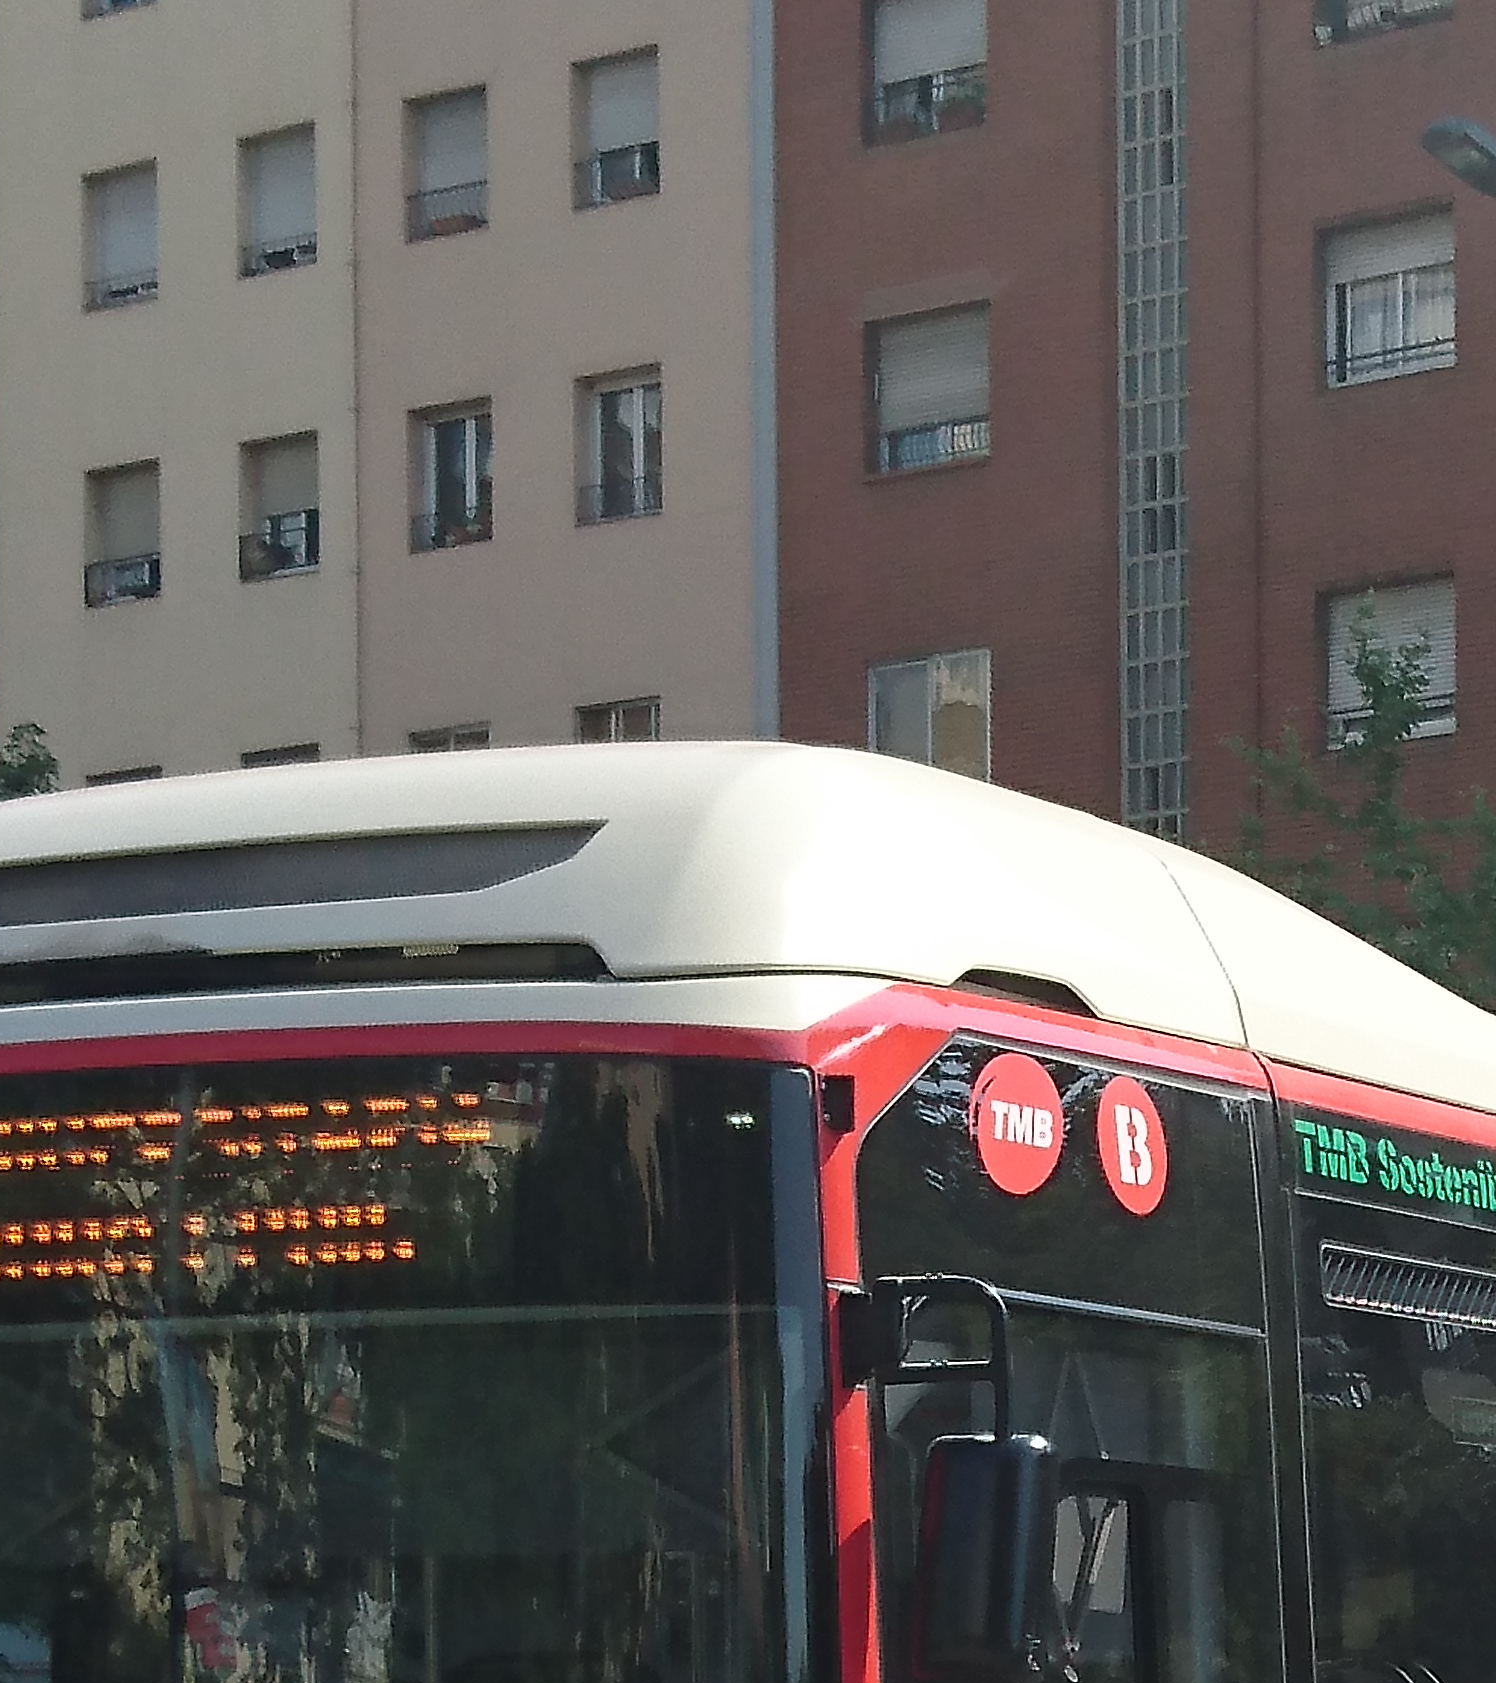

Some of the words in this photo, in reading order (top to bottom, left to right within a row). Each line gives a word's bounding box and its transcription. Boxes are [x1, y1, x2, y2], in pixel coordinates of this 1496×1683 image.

[990, 1099, 1054, 1149] TMB
[1114, 1104, 1153, 1187] B
[1293, 1119, 1370, 1185] TMB
